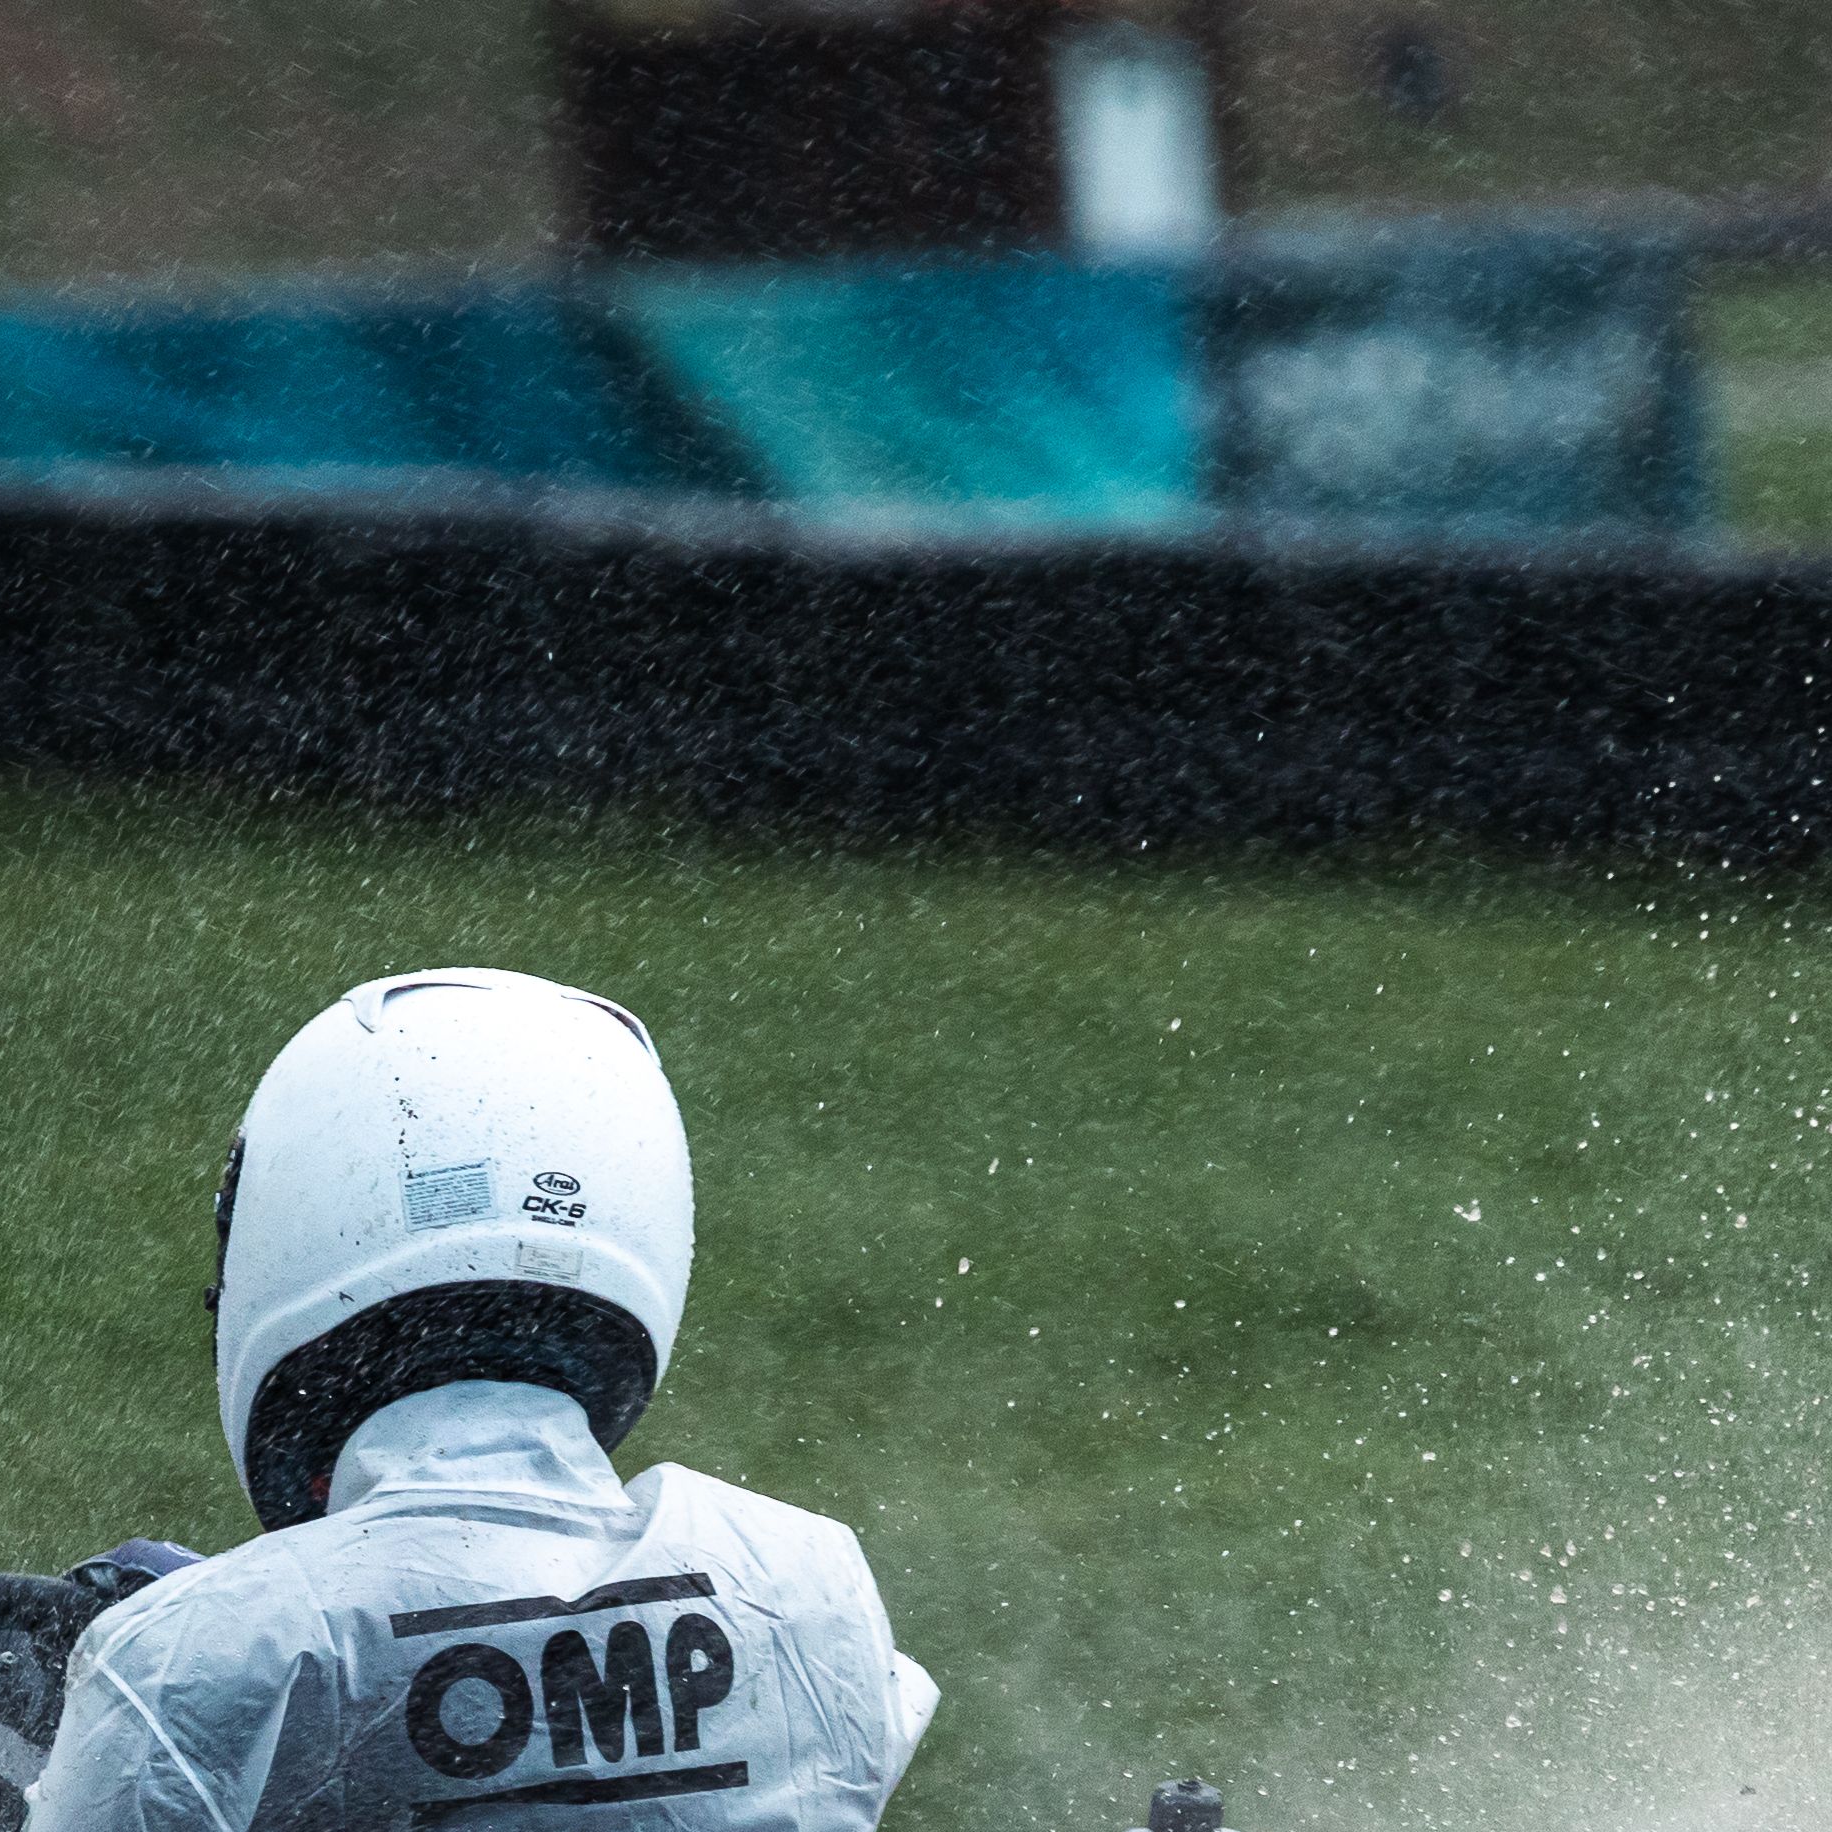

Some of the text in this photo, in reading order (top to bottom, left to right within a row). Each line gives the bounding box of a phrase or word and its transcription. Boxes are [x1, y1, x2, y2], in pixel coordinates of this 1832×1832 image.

[540, 1173, 575, 1191] Arai
[522, 1195, 587, 1219] CK-6
[405, 1612, 735, 1780] OMP
